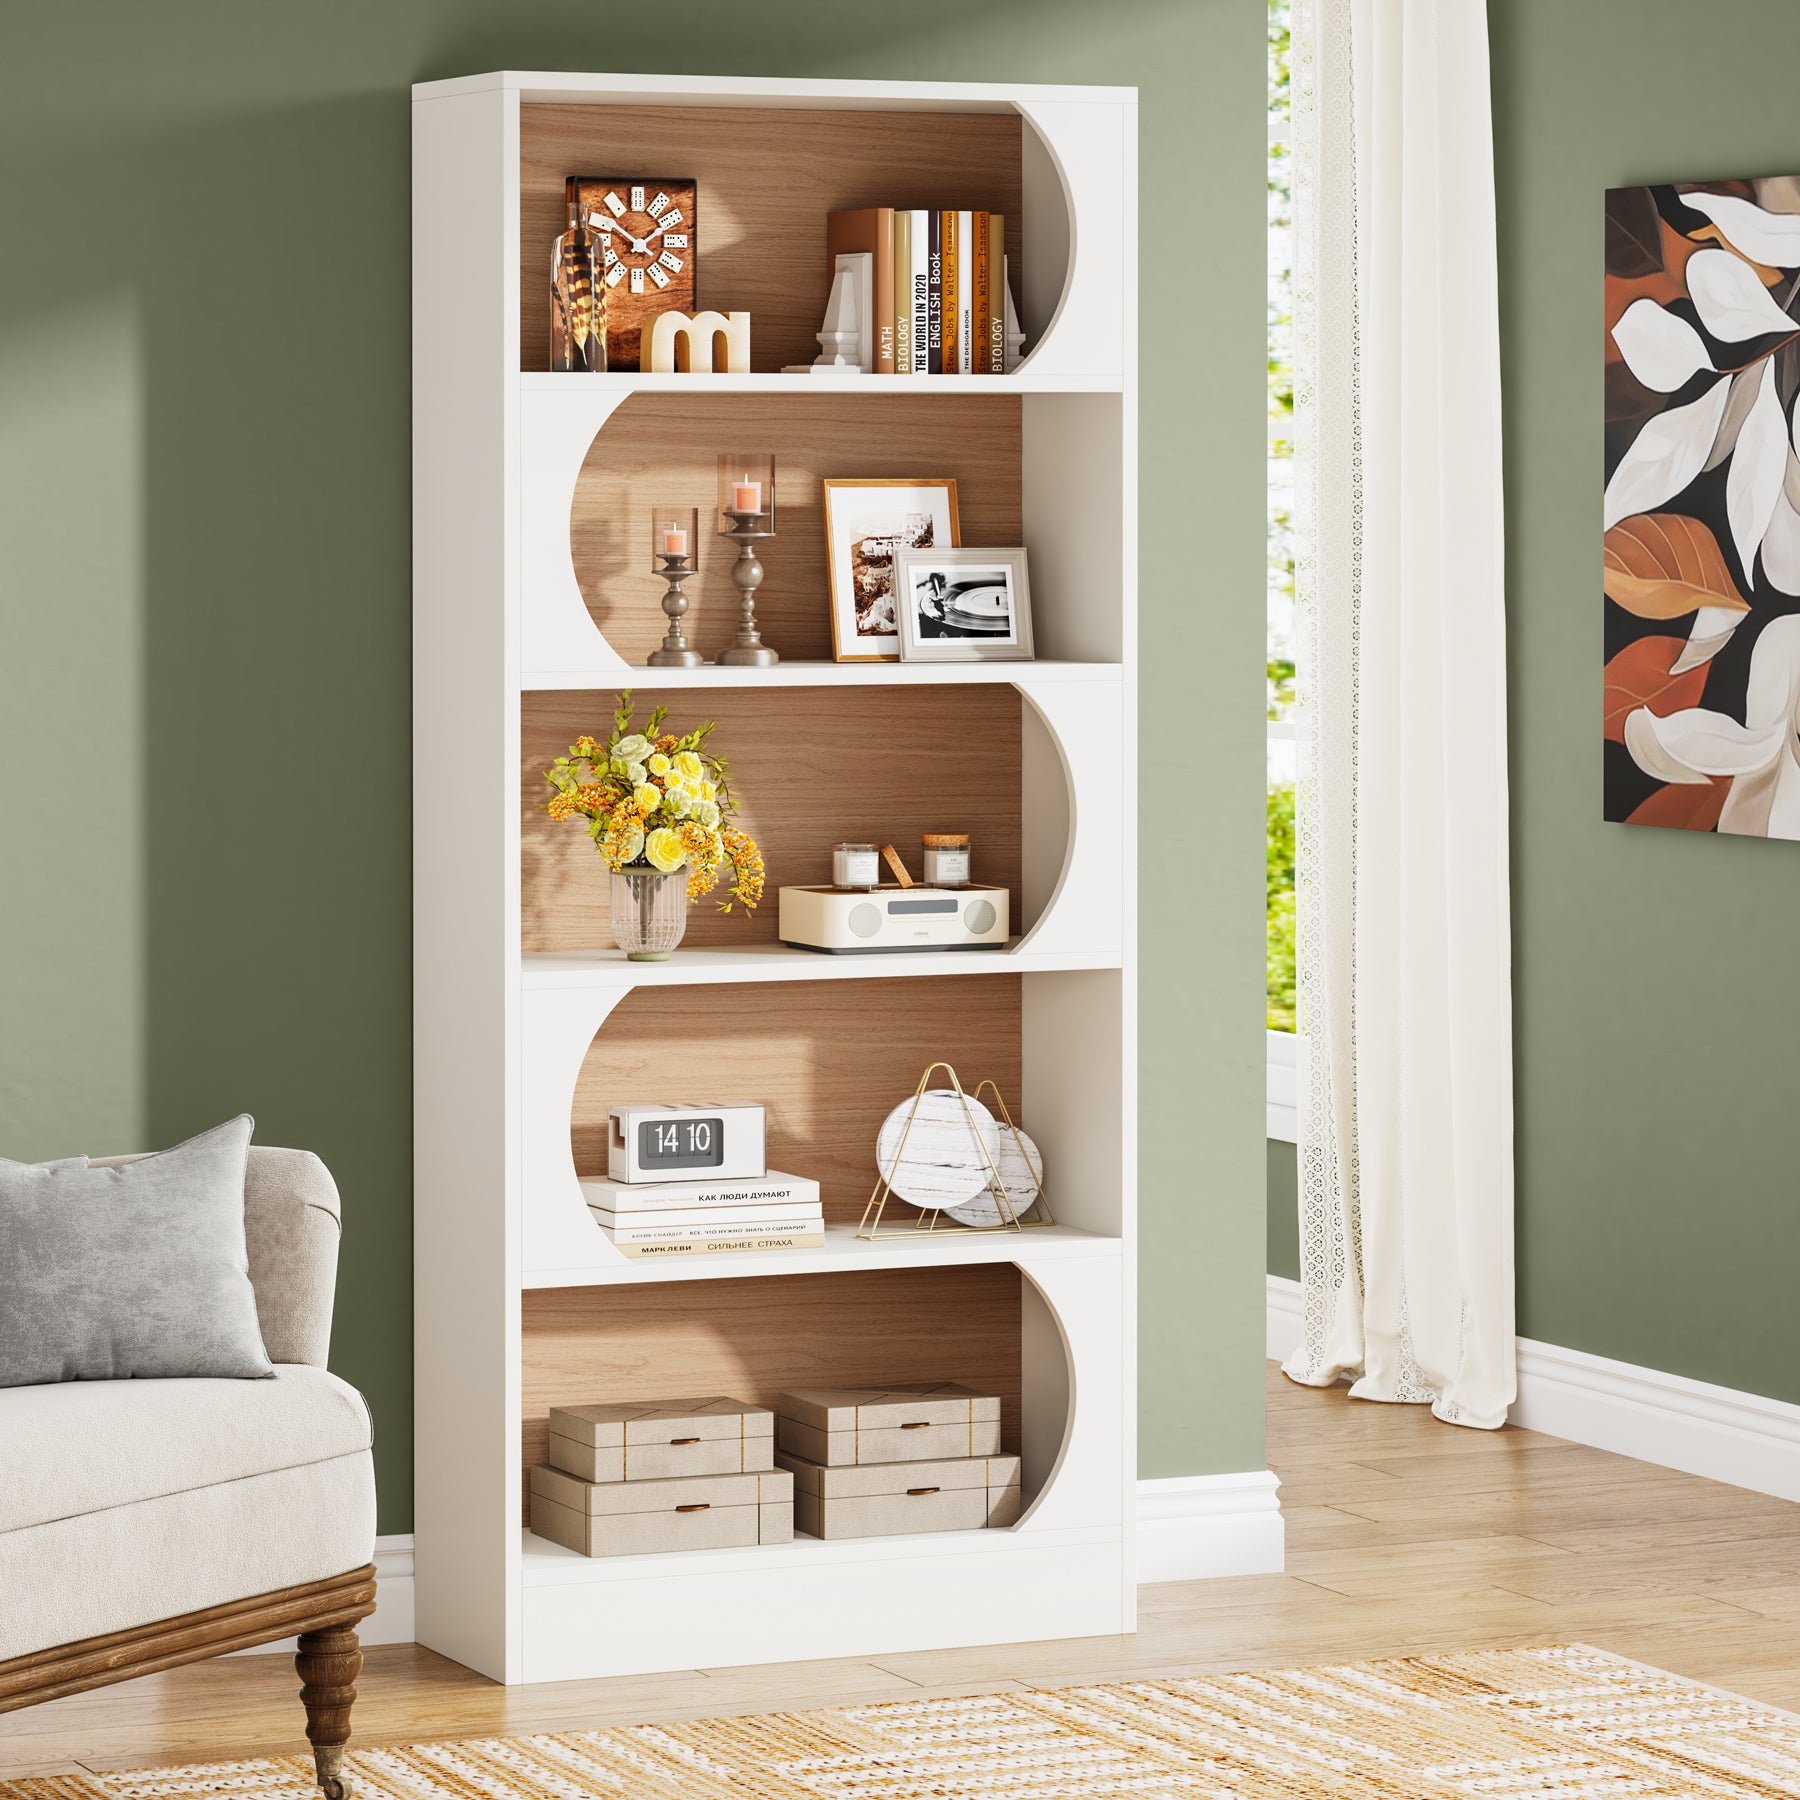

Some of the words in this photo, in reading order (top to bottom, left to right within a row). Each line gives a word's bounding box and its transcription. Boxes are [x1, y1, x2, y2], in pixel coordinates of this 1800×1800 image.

[978, 213, 987, 257] Isaacson
[929, 252, 941, 284] Book
[946, 263, 955, 296] Walter
[978, 263, 987, 296] Walter
[915, 274, 927, 300] 2020
[915, 303, 927, 313] IN
[930, 292, 941, 348] ENGLISH
[946, 301, 956, 312] by
[978, 301, 988, 312] by
[881, 326, 893, 359] MATH
[915, 315, 927, 352] WORLD
[946, 317, 955, 340] Jobs
[978, 317, 987, 340] Jobs
[898, 316, 909, 371] BIOLOGY
[992, 317, 1003, 372] BIOLOGY
[915, 353, 927, 372] THE
[946, 345, 955, 373] Steve
[978, 345, 987, 373] Steve
[654, 1124, 679, 1153] 14
[686, 1122, 711, 1152] 10
[698, 1194, 717, 1202] КАК
[719, 1192, 748, 1201] ЛЮДИ
[750, 1190, 791, 1200] ДУМАЮТ
[707, 1241, 753, 1250] СИЛЬНЕЕ
[757, 1239, 793, 1248] СТРАХА
